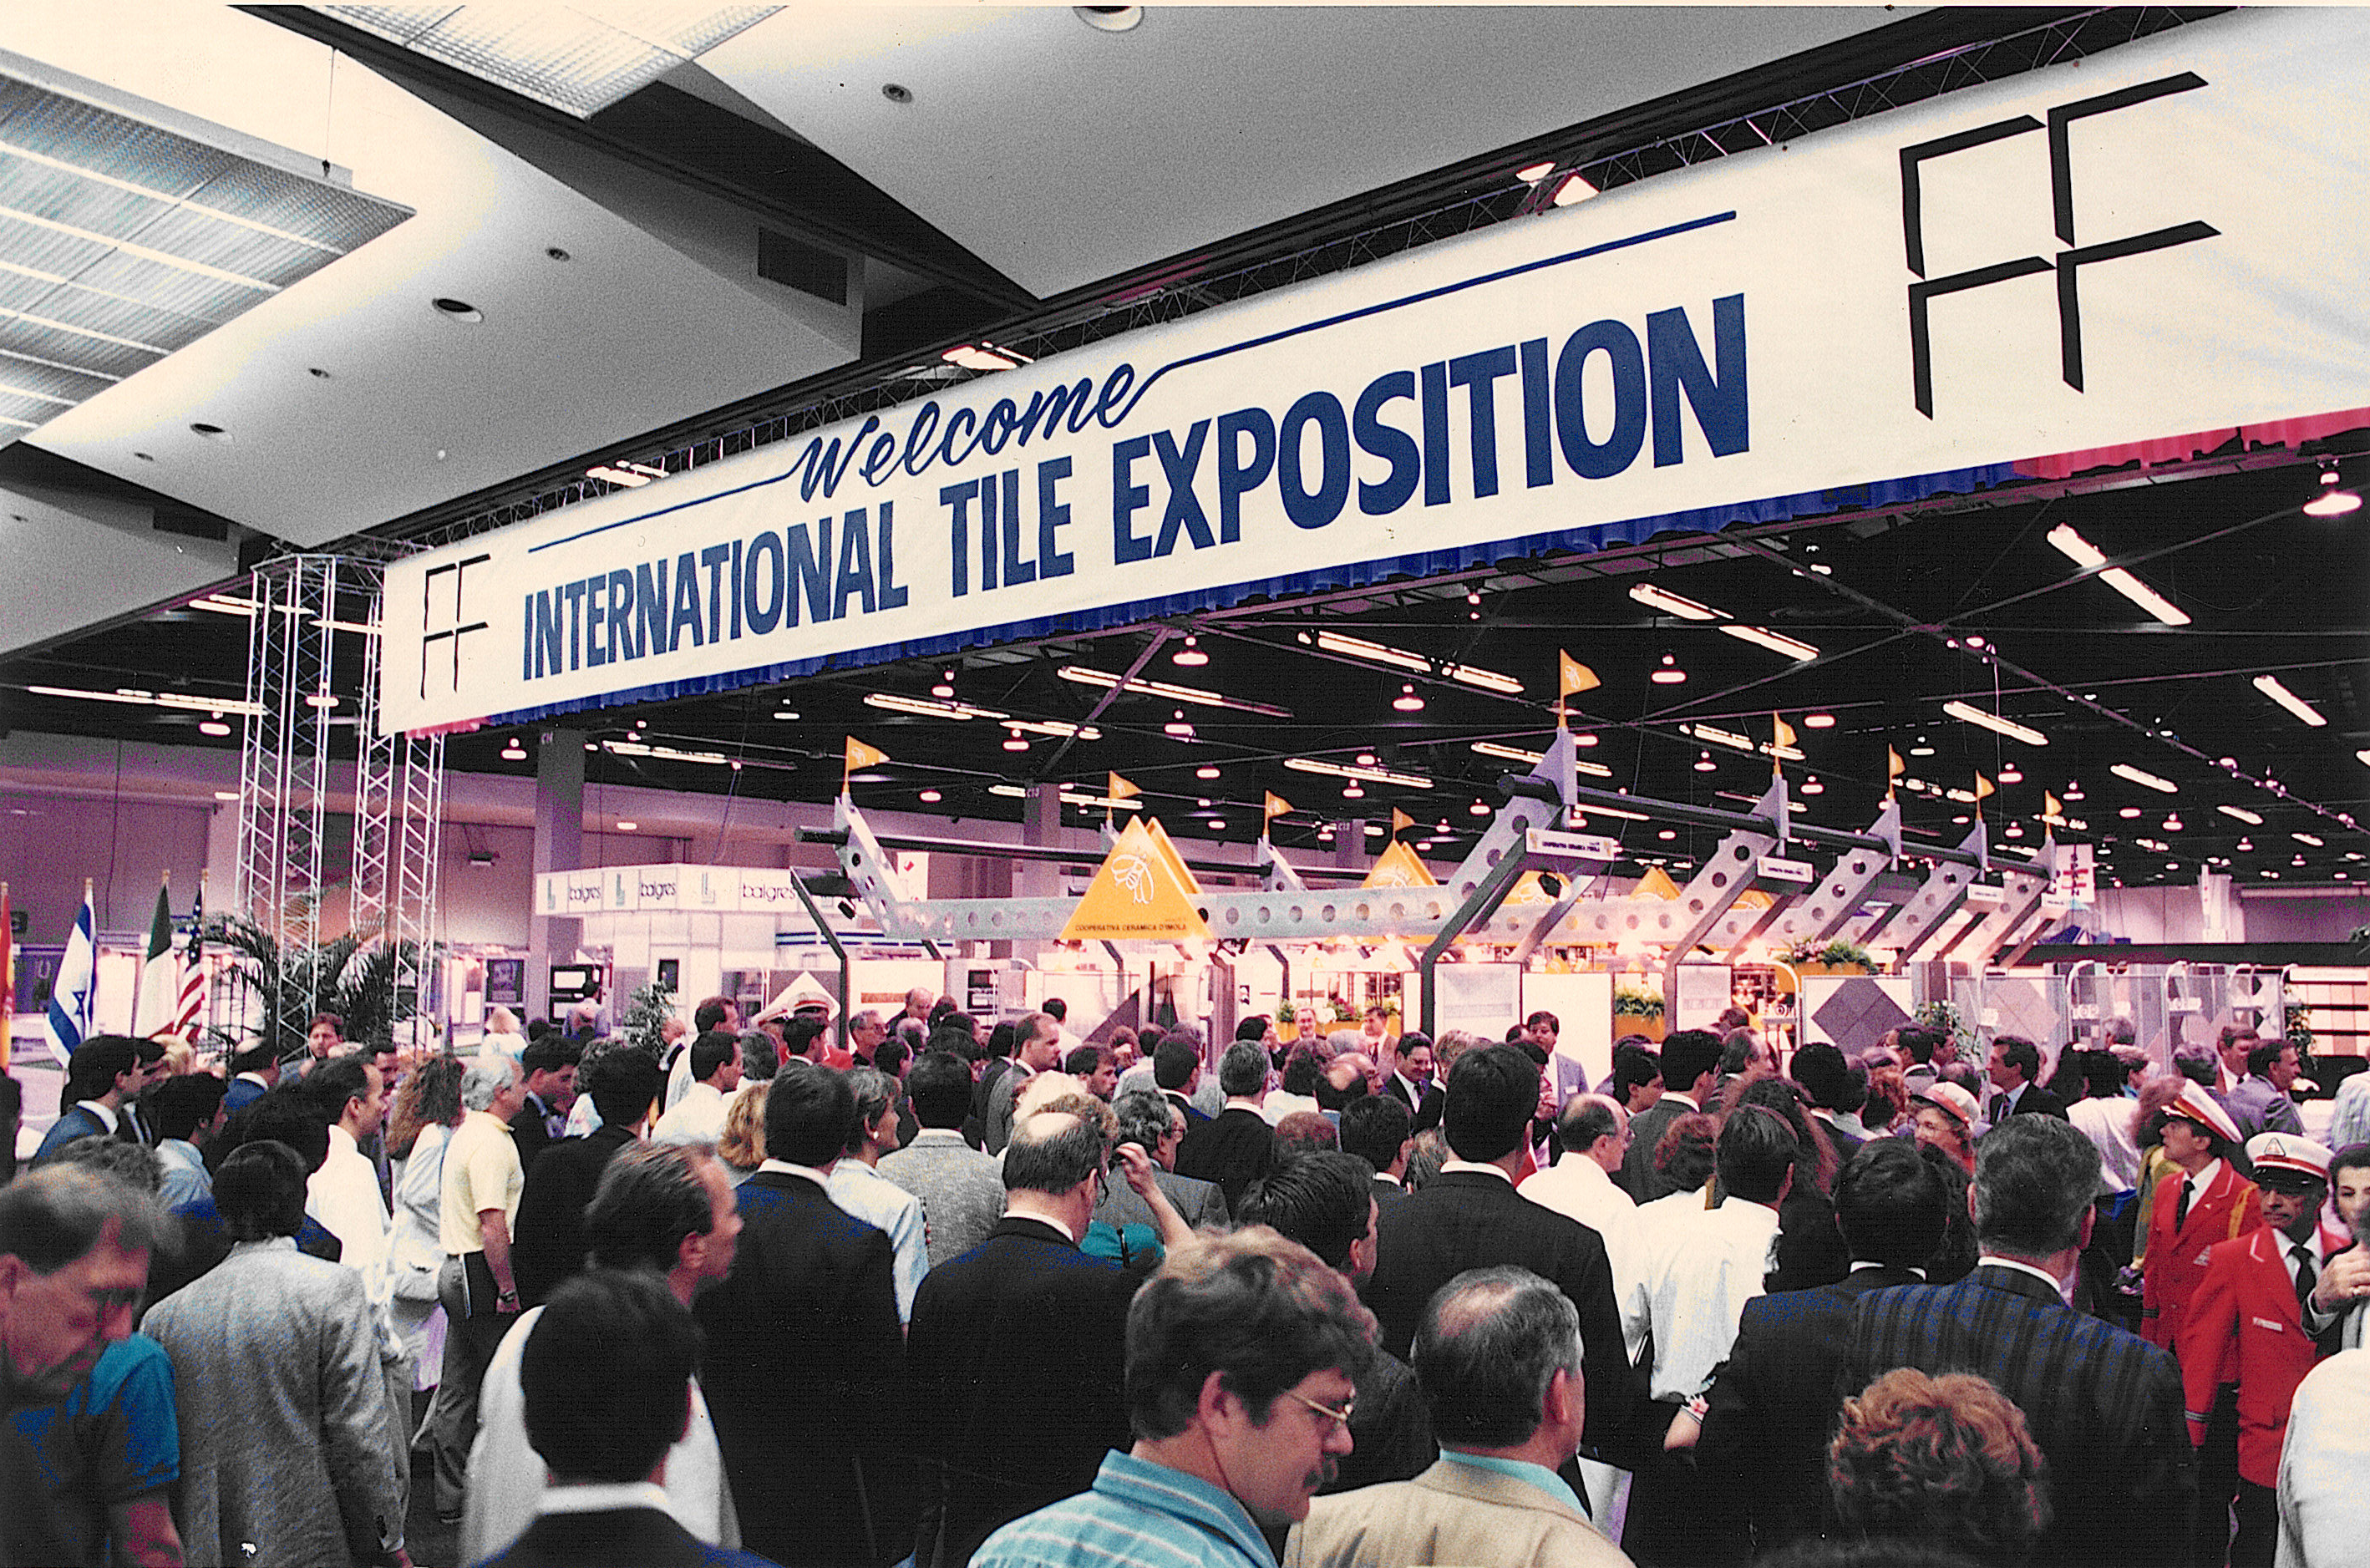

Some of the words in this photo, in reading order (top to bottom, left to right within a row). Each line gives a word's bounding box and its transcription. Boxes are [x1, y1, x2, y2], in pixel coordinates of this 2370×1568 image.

[789, 363, 1134, 503] Welcome
[523, 500, 909, 681] INTERNATIONAL
[940, 455, 1074, 598] TILE
[1113, 292, 1751, 566] EXPOSITION
[742, 883, 796, 903] balgres
[1122, 922, 1157, 931] CERAMICA
